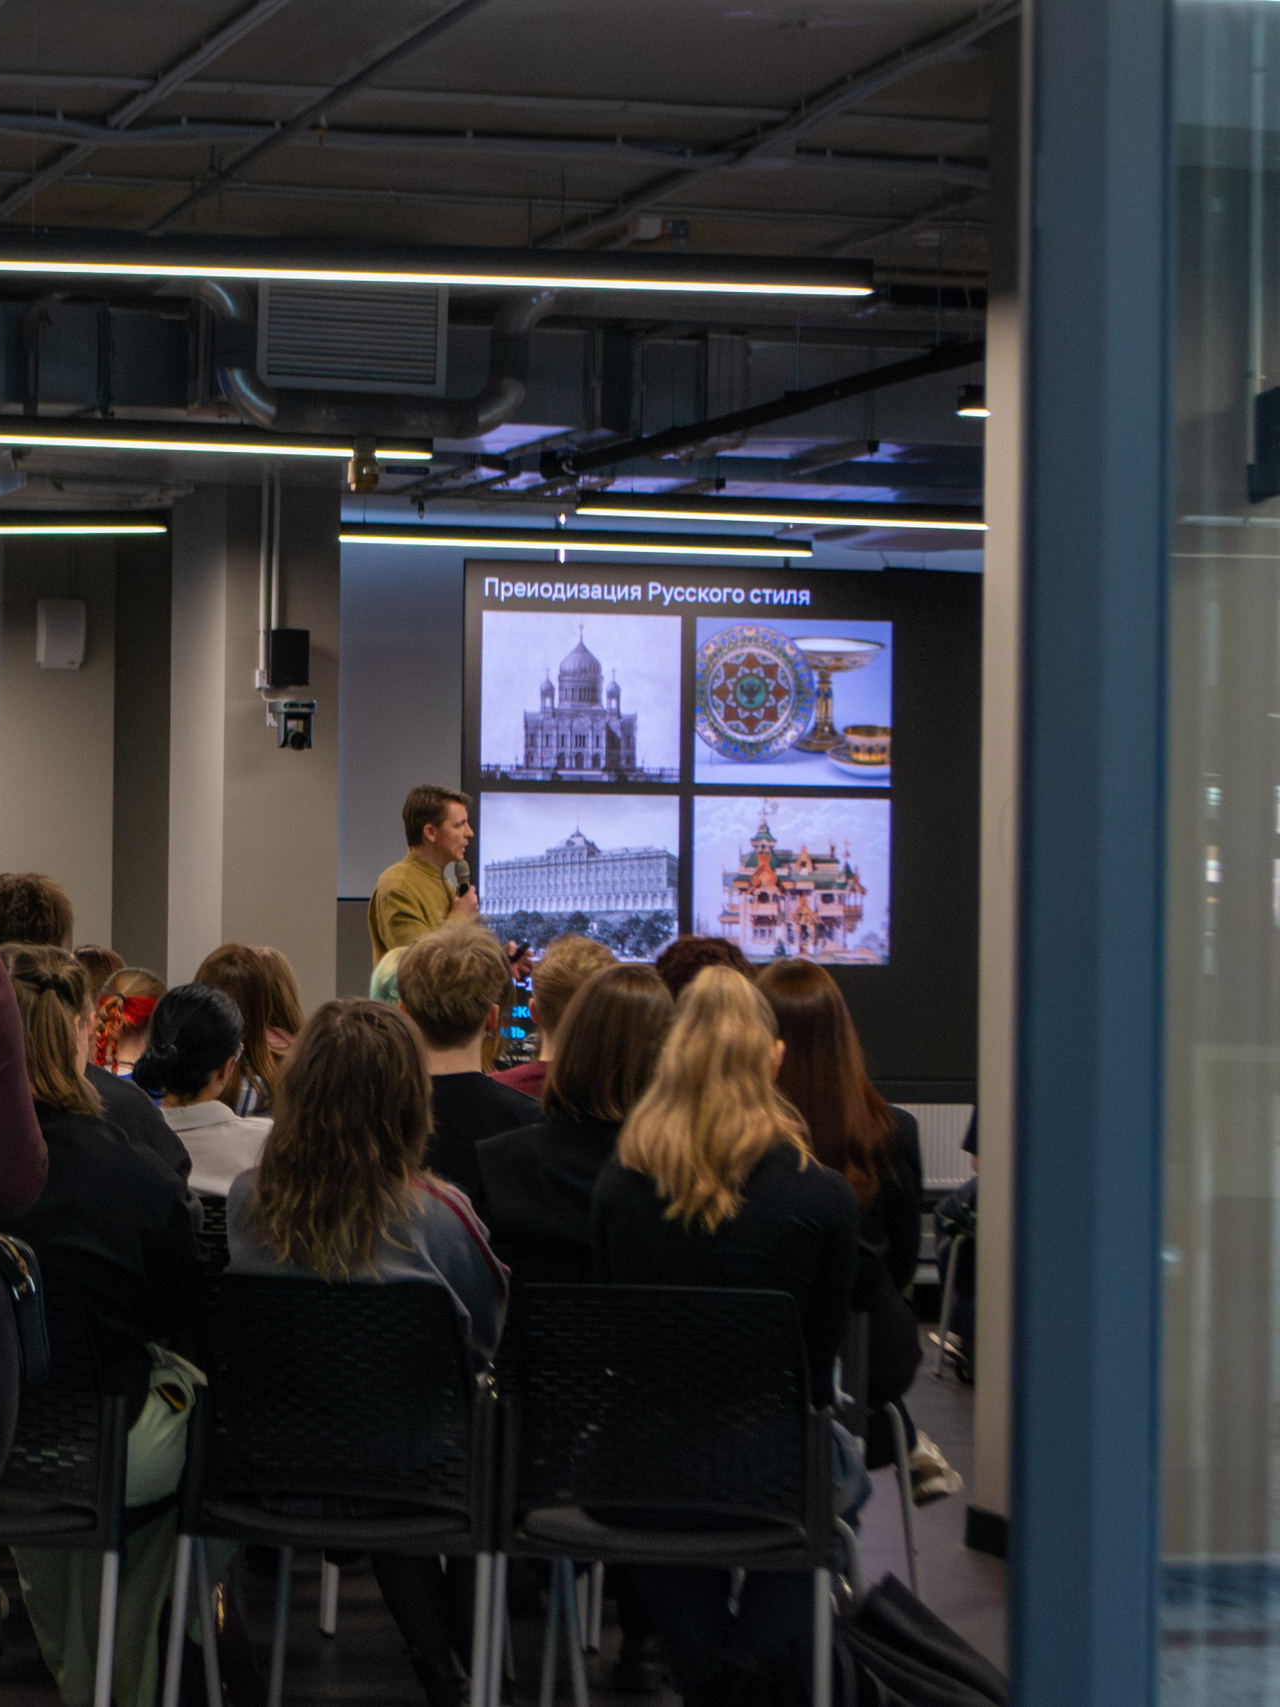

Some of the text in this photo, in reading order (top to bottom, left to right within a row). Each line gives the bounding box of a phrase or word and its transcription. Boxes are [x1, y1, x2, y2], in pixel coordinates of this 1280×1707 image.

[484, 576, 811, 606] Преиодизация Русского стиля
